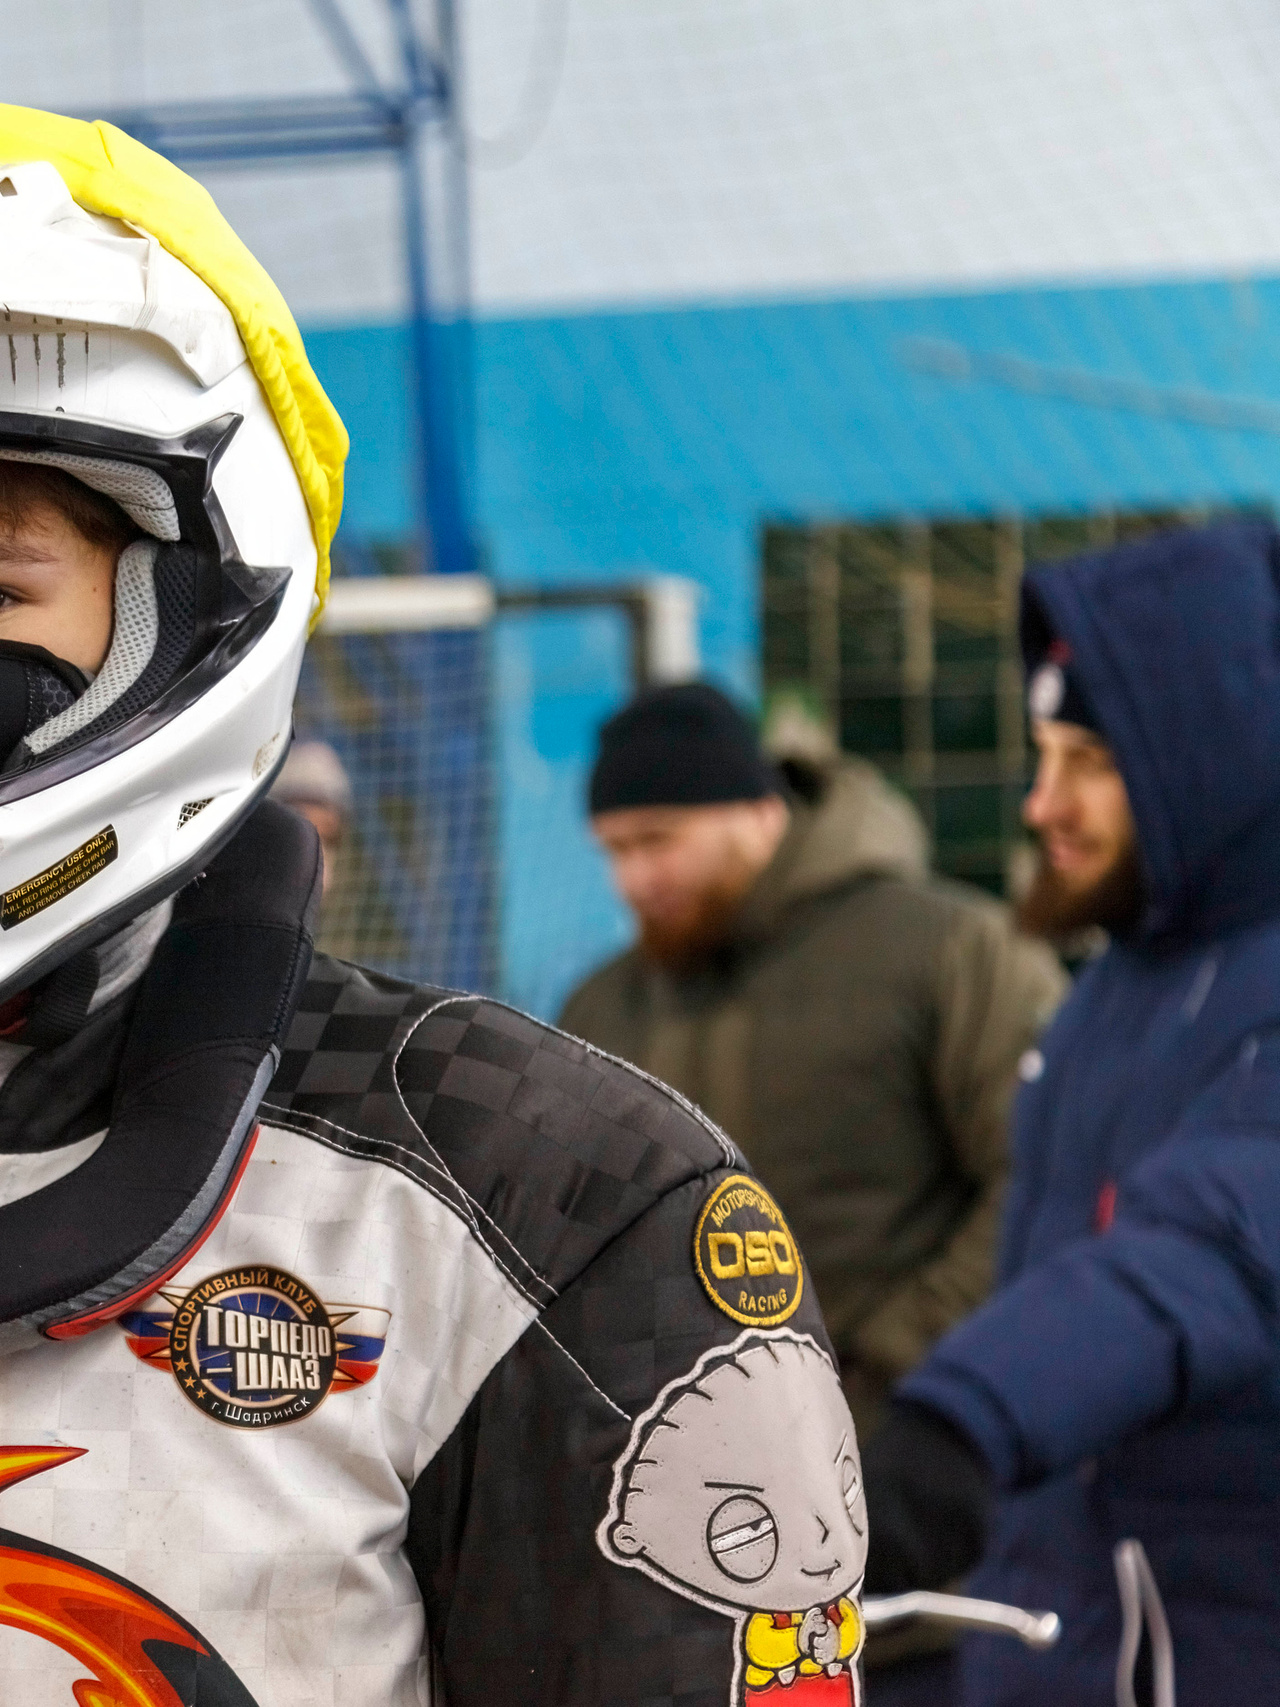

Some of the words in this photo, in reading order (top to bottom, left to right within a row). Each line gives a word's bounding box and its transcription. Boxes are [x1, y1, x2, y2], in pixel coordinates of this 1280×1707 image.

[2, 903, 20, 916] PULL
[22, 892, 39, 906] RED
[40, 880, 58, 899] RING
[59, 866, 82, 883] INSIDE
[83, 851, 100, 868] CHIN
[100, 840, 115, 855] BAR
[6, 865, 64, 904] EMERGENCY
[66, 850, 85, 867] USE
[86, 833, 108, 854] ONLY
[18, 905, 35, 919] AND
[36, 887, 66, 909] REMOVE
[68, 870, 92, 889] CHEEK
[92, 858, 106, 873] PAD
[174, 1269, 269, 1352] СПОРТИВНЫЙ
[273, 1276, 317, 1314] КЛУБ
[203, 1305, 332, 1360] ТОРПЕДО
[738, 1288, 787, 1312] RACING
